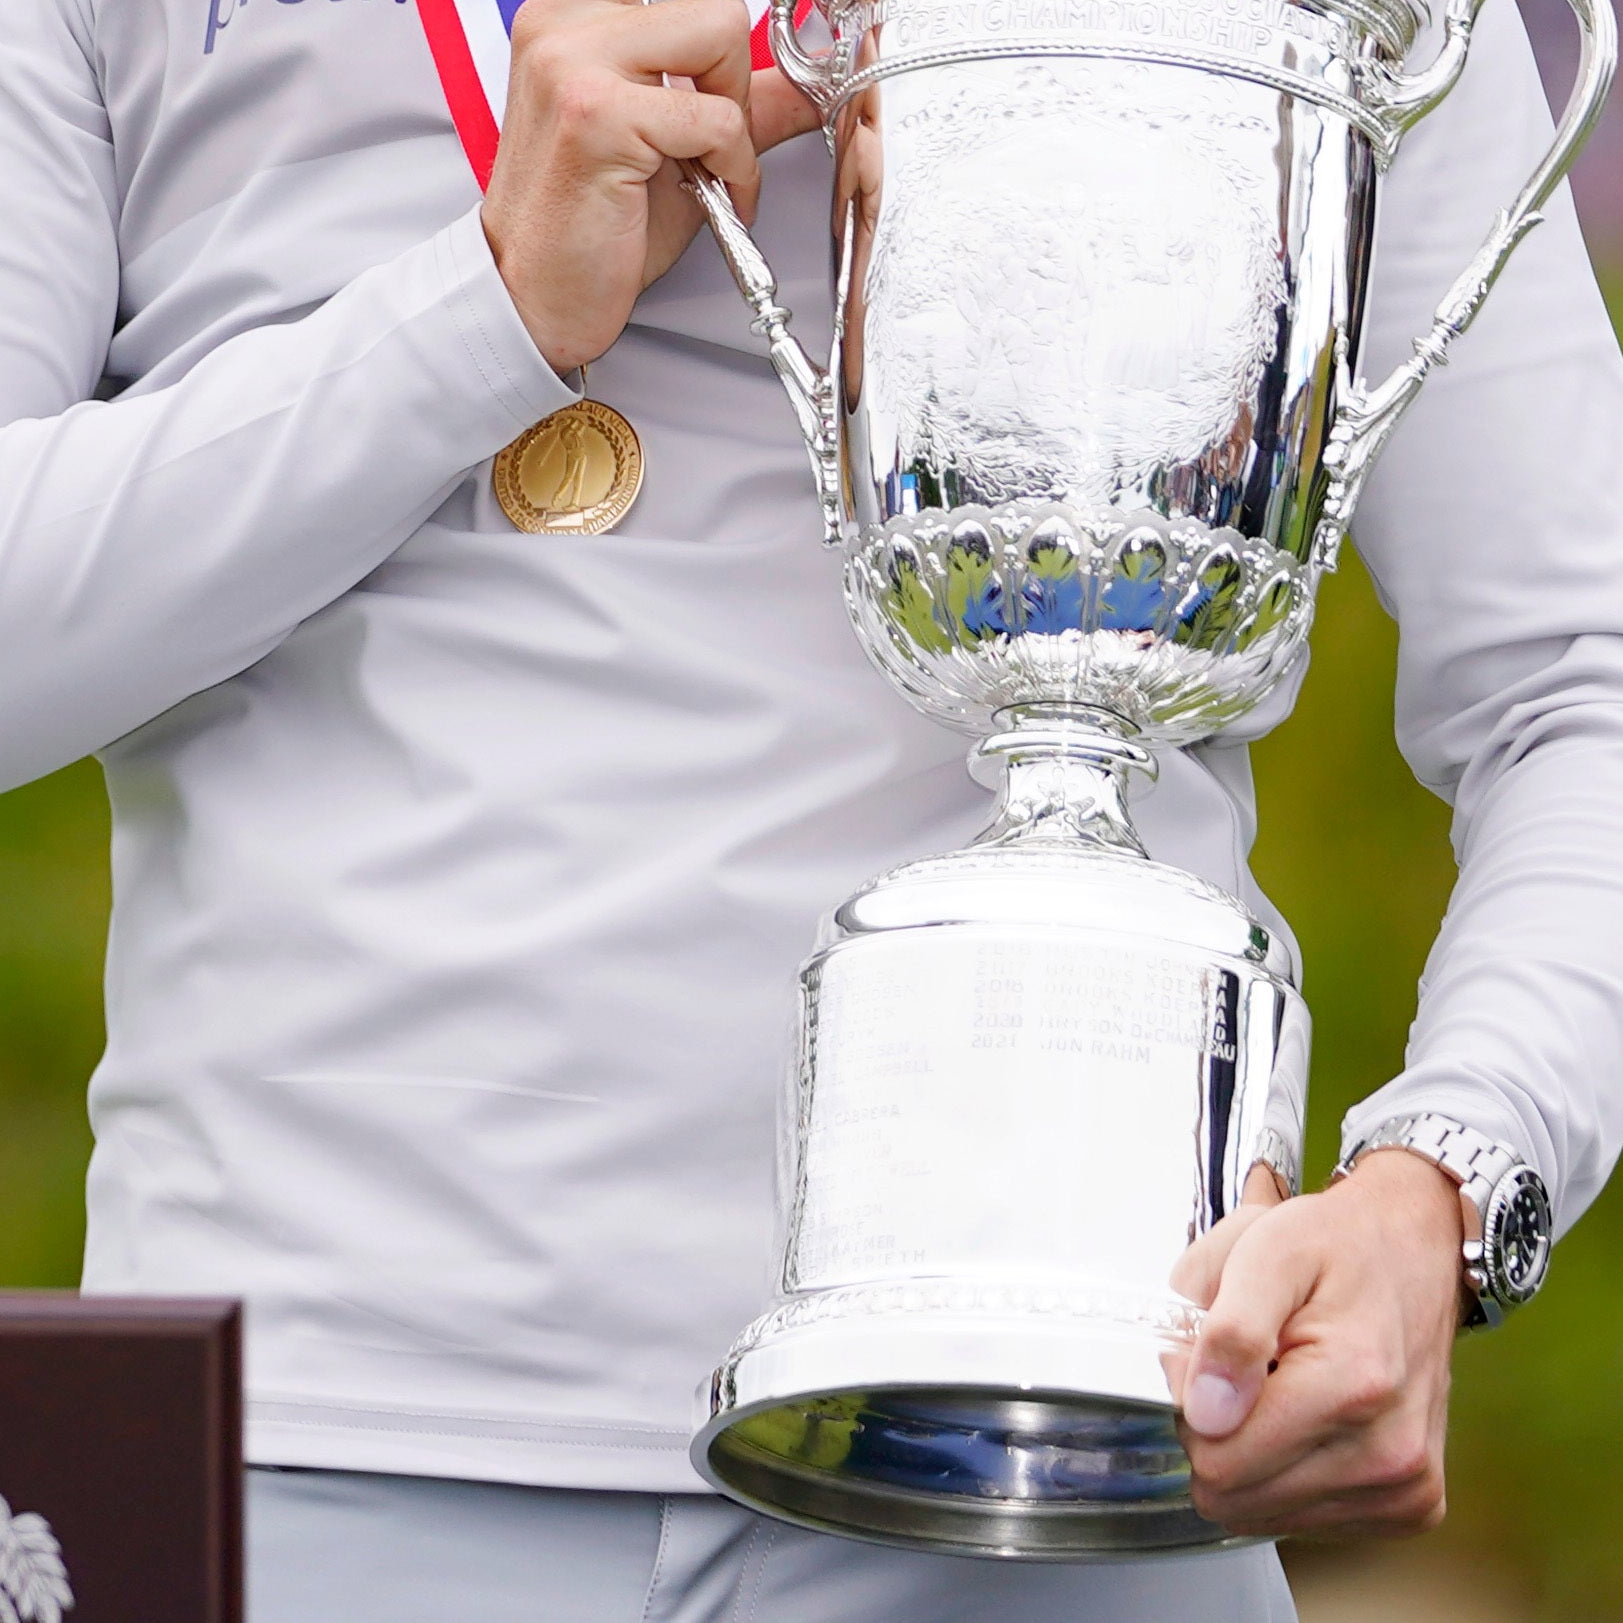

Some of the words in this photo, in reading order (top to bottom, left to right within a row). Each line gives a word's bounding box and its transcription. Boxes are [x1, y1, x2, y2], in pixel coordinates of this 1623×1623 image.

[897, 2, 977, 48] OPEN
[970, 1033, 1017, 1050] 2021
[1090, 1038, 1151, 1064] RAHM
